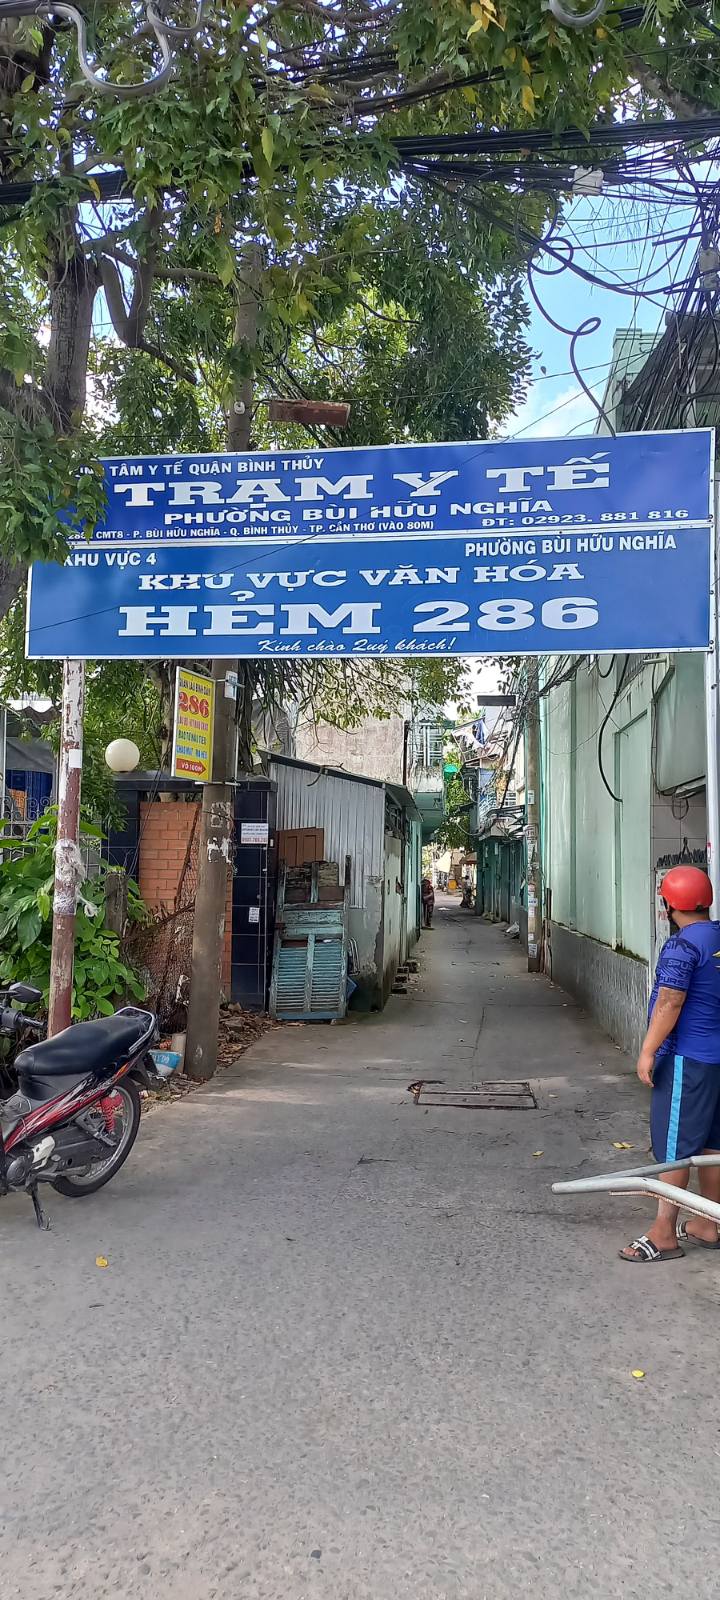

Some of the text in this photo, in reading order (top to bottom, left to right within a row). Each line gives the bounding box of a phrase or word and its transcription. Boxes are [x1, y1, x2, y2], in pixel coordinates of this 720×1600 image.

[109, 463, 144, 477] TÂM
[148, 465, 158, 476] Y
[163, 459, 184, 476] TẾ
[189, 461, 232, 476] QUẬN
[237, 458, 276, 474] BÌNH
[282, 456, 325, 472] THỦY
[113, 452, 612, 508] TRẠM Y TẾ
[164, 497, 554, 525] PHƯỜNG BÙI HỮU NGHĨA
[482, 510, 689, 527] ĐT: 02923. 881 816
[96, 531, 123, 540] CMT8
[133, 531, 143, 539] P.
[146, 528, 164, 539] BÙI
[166, 527, 187, 538] HỮU
[190, 526, 221, 537] NGHĨA
[230, 527, 240, 536] Q.
[243, 525, 268, 536] BÌNH
[271, 523, 299, 534] THỦY
[309, 525, 326, 533] TP.
[329, 521, 351, 533] CẦN
[353, 521, 376, 532] THƠ
[379, 521, 404, 532] (VÀO
[407, 521, 434, 531] 80M)
[465, 530, 678, 558] PHƯỜNG BÙI HỮU NGHĨA
[64, 550, 157, 570] KHU VỰC 4
[138, 559, 585, 592] KHU VỰC VĂN HÓA
[117, 590, 600, 637] HẺM 286
[258, 636, 458, 654] Kính chào Quý khách!
[179, 691, 210, 719] 286
